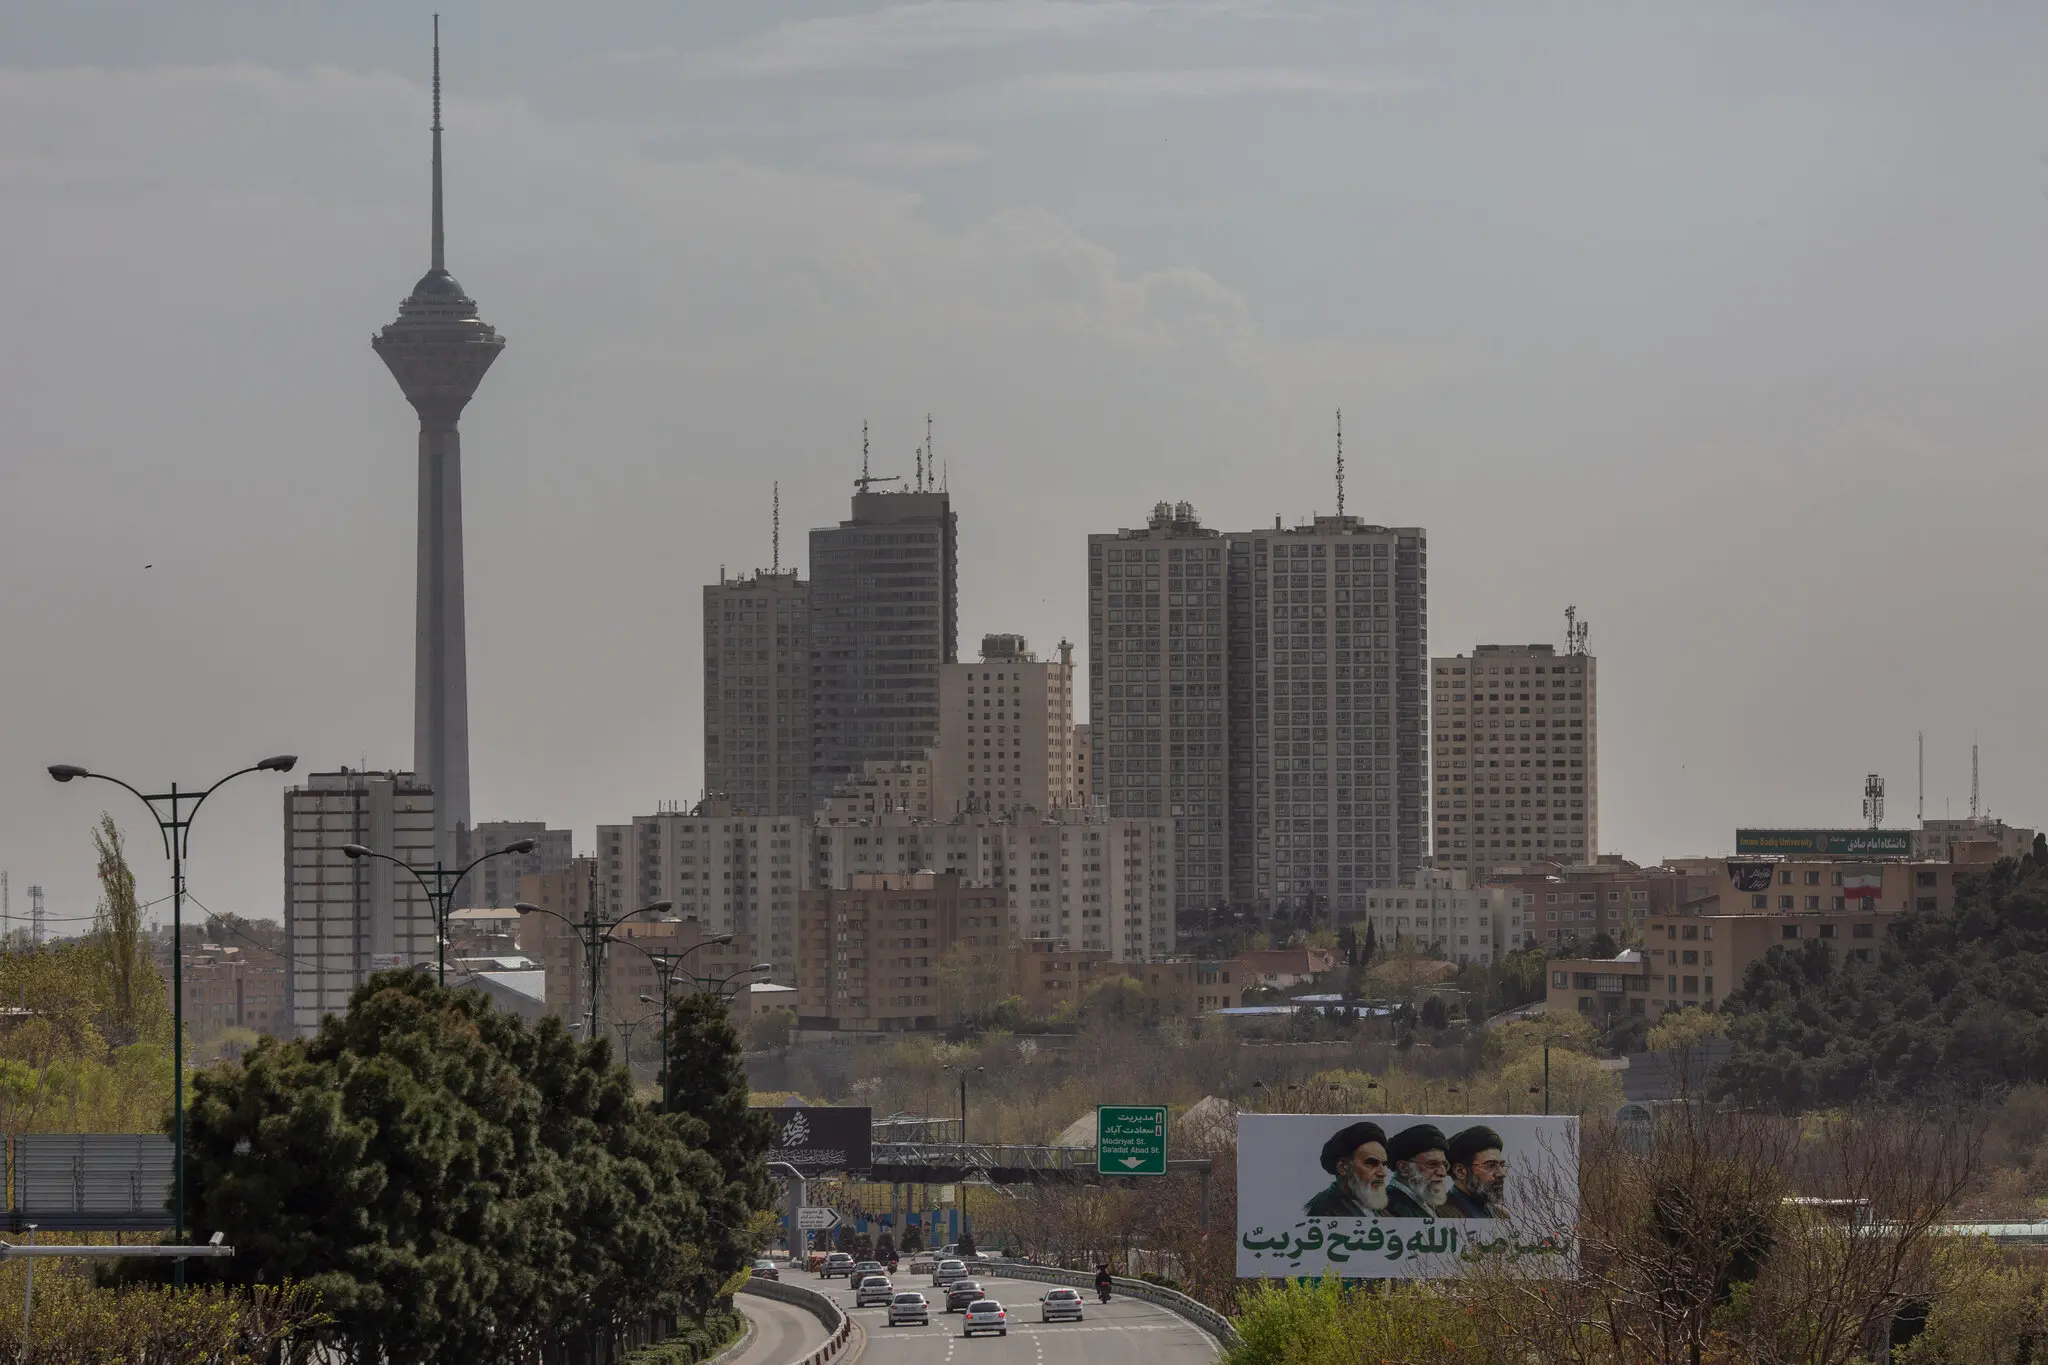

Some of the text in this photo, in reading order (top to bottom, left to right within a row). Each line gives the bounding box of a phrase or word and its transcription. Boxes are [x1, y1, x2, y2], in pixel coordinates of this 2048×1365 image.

[1779, 836, 1813, 848] University
[1847, 837, 1866, 852] صادق
[1881, 836, 1906, 849] دانشگاه
[1117, 1113, 1154, 1123] مدیریت
[1104, 1124, 1154, 1135] سعادت آباد
[1102, 1137, 1146, 1146] Modiriyat St.
[1130, 1146, 1149, 1154] Abad
[1150, 1146, 1161, 1154] St.
